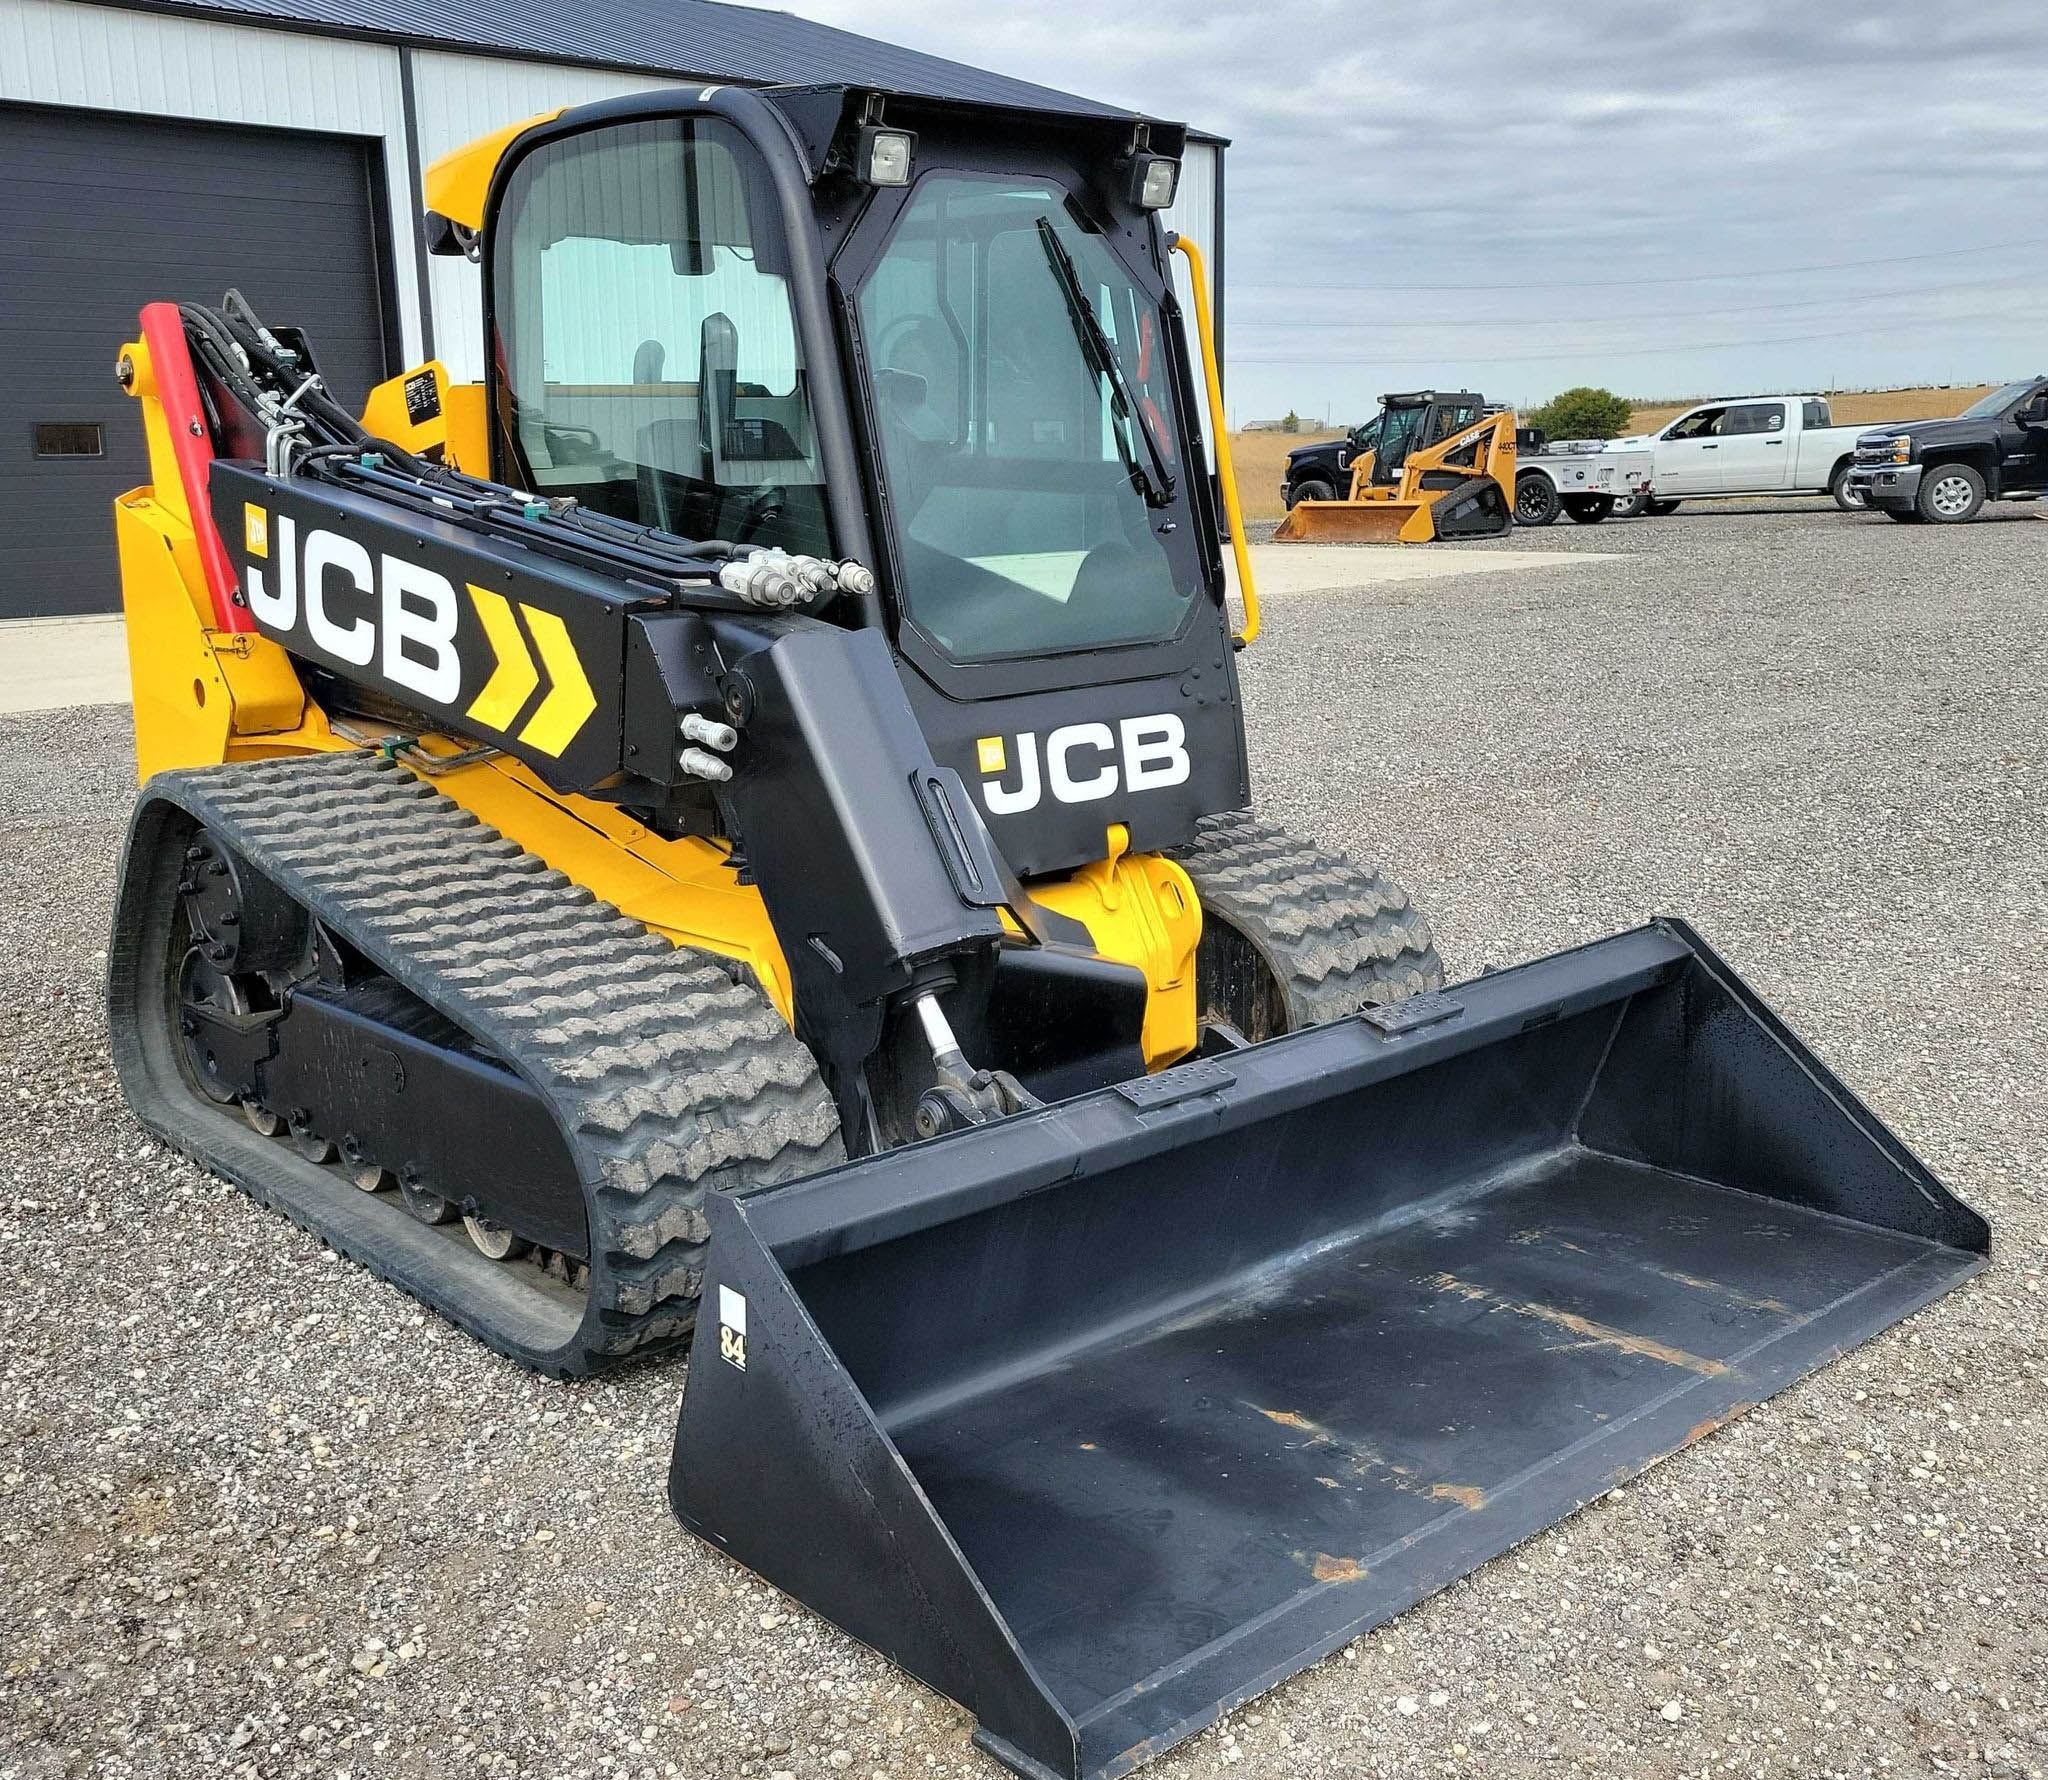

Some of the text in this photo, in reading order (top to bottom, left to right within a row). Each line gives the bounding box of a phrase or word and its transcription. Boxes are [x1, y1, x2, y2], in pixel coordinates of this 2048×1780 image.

[1460, 430, 1480, 446] CASE
[247, 514, 461, 704] JCB
[982, 713, 1190, 815] JCB
[721, 1325, 746, 1367] 84
